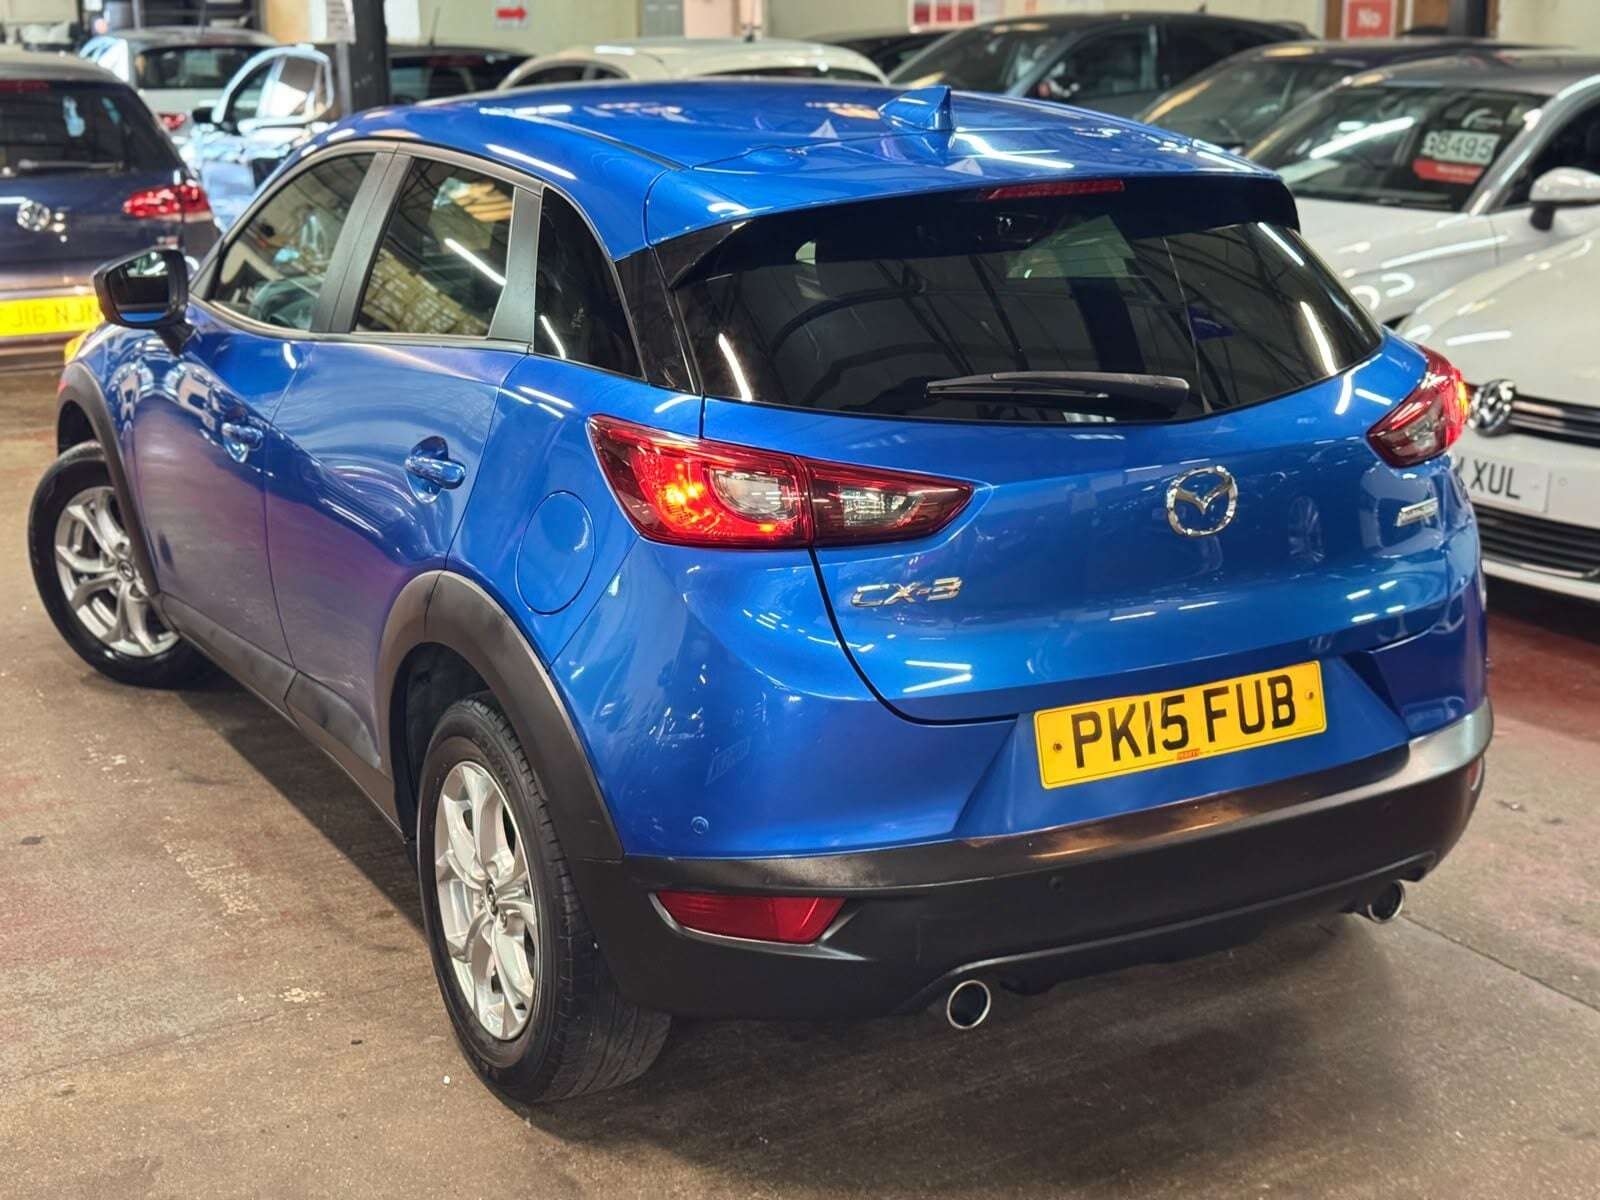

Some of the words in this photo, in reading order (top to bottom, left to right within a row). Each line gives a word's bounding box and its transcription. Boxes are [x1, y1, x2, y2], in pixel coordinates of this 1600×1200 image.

[1470, 458, 1521, 499] XUL
[851, 577, 962, 608] CX-3
[1071, 694, 1189, 769] PK15
[1202, 674, 1296, 743] FUB
